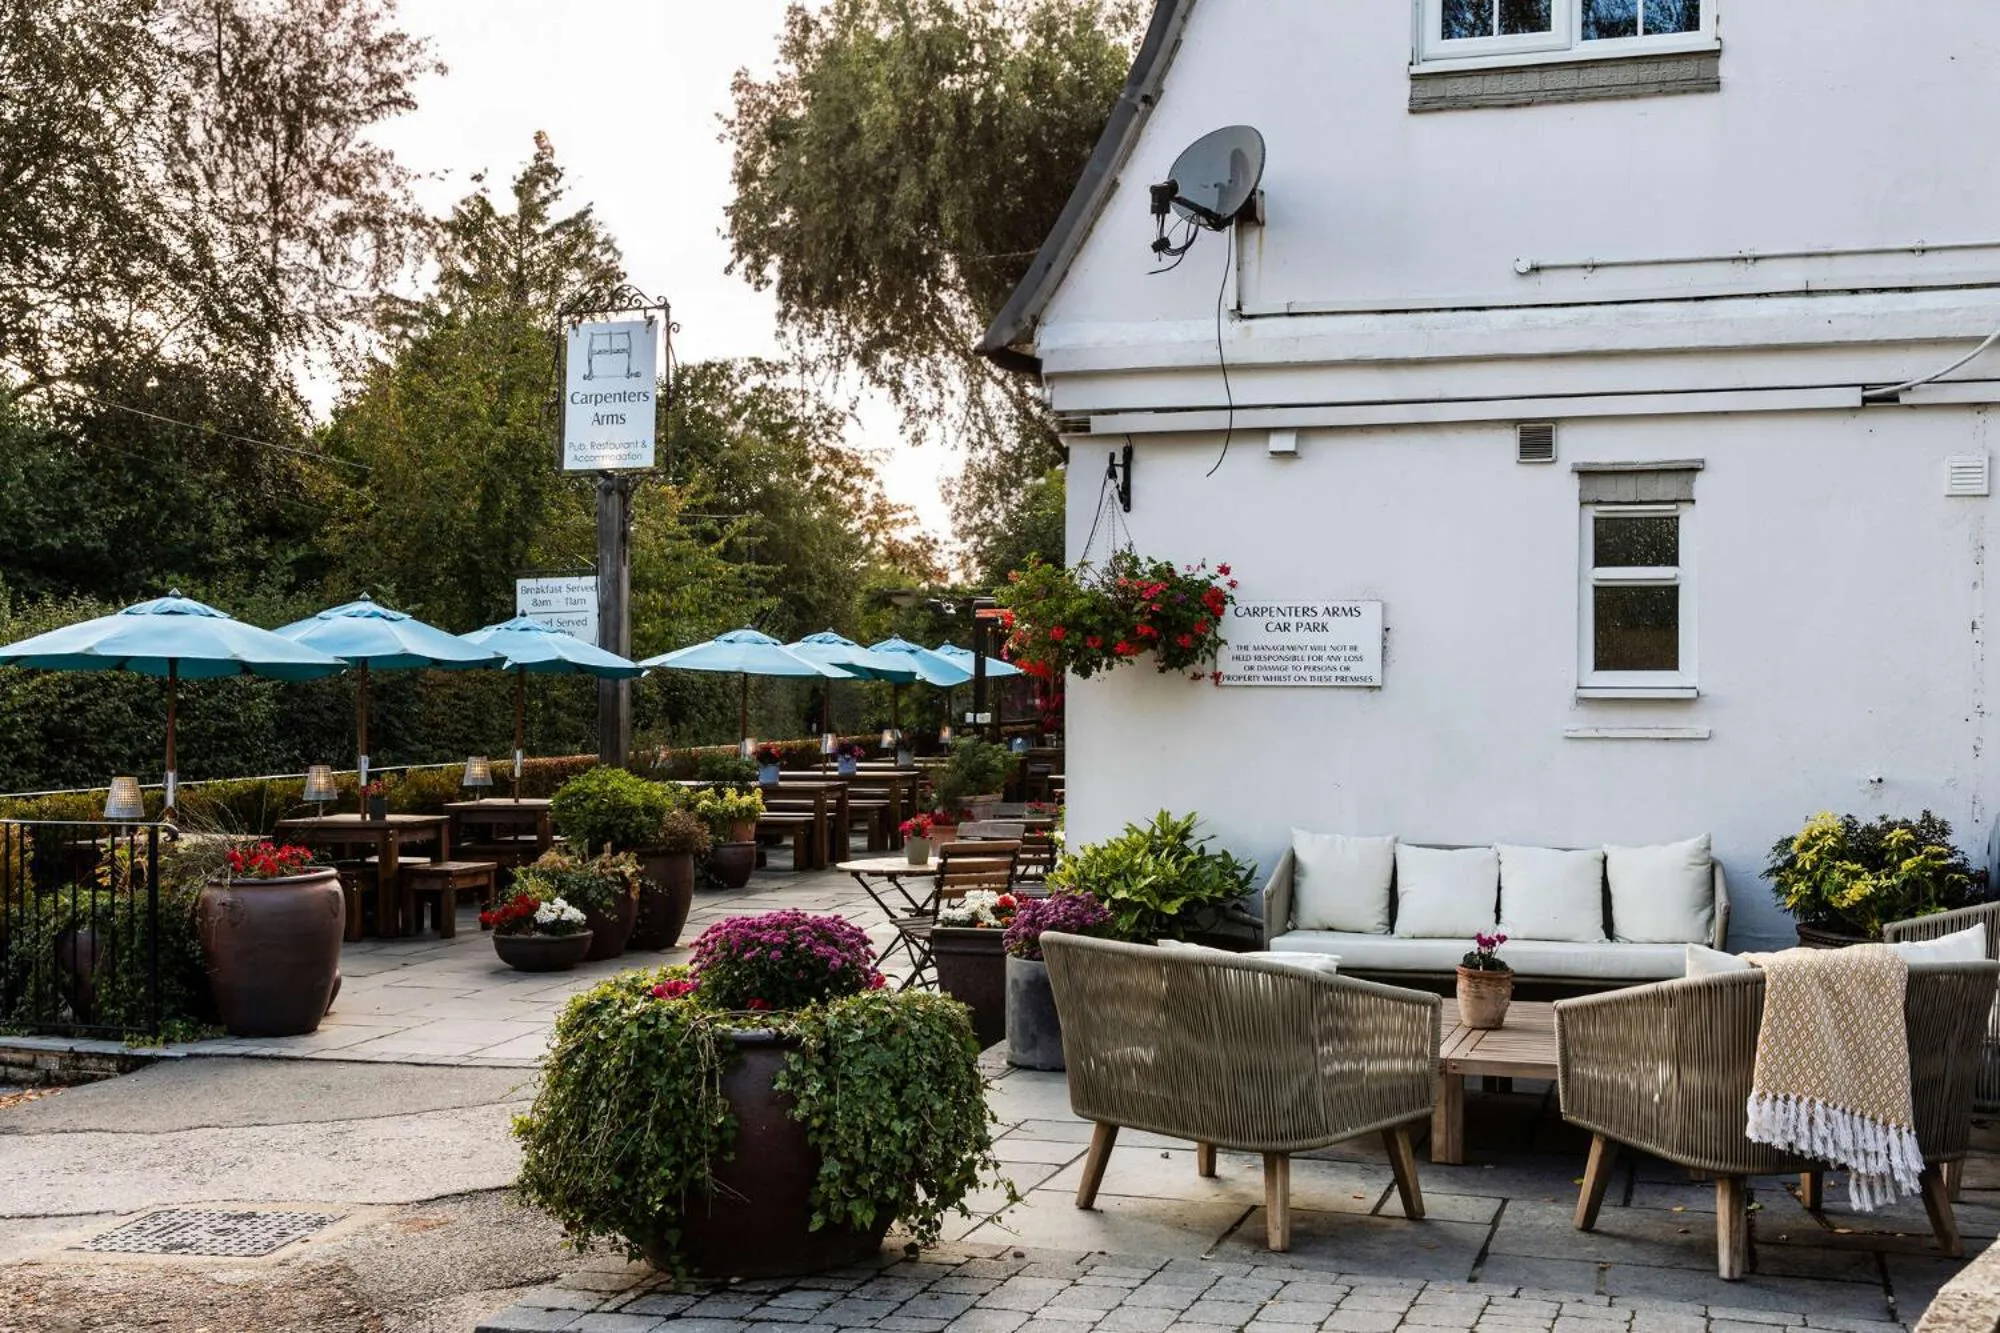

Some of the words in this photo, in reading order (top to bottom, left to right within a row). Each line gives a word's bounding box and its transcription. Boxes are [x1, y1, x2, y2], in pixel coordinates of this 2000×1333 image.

[570, 391, 650, 407] Carpenters
[591, 412, 627, 426] Arms
[590, 440, 639, 450] Restaurant
[641, 440, 647, 449] &
[572, 452, 643, 463] Accommodation
[520, 584, 562, 595] Breakfast
[531, 597, 552, 607] 8am
[1234, 605, 1318, 618] CARPENTERS
[1322, 605, 1362, 618] ARMS
[556, 616, 588, 627] Served
[1264, 621, 1291, 633] CAR
[1295, 621, 1330, 633] PARK
[1236, 644, 1249, 652] THE
[1252, 644, 1309, 652] MANAGEMENT
[1309, 644, 1327, 652] WILL
[1330, 644, 1348, 652] NOT
[1349, 644, 1358, 652] BE
[1231, 654, 1251, 662] HELD
[1254, 654, 1304, 662] RESPONSIBLE
[1307, 654, 1323, 662] FOR
[1326, 654, 1341, 662] ANY
[1343, 654, 1364, 662] LOSS
[1243, 664, 1255, 672] OR
[1256, 664, 1289, 672] DAMAGE
[1291, 664, 1302, 672] TO
[1303, 664, 1338, 672] PERSONS
[1339, 664, 1351, 672] OR
[1222, 674, 1261, 682] PROPERTY
[1262, 674, 1291, 682] WHILST
[1293, 674, 1307, 682] ON
[1310, 674, 1332, 682] THESE
[1335, 674, 1373, 683] PREMISES
